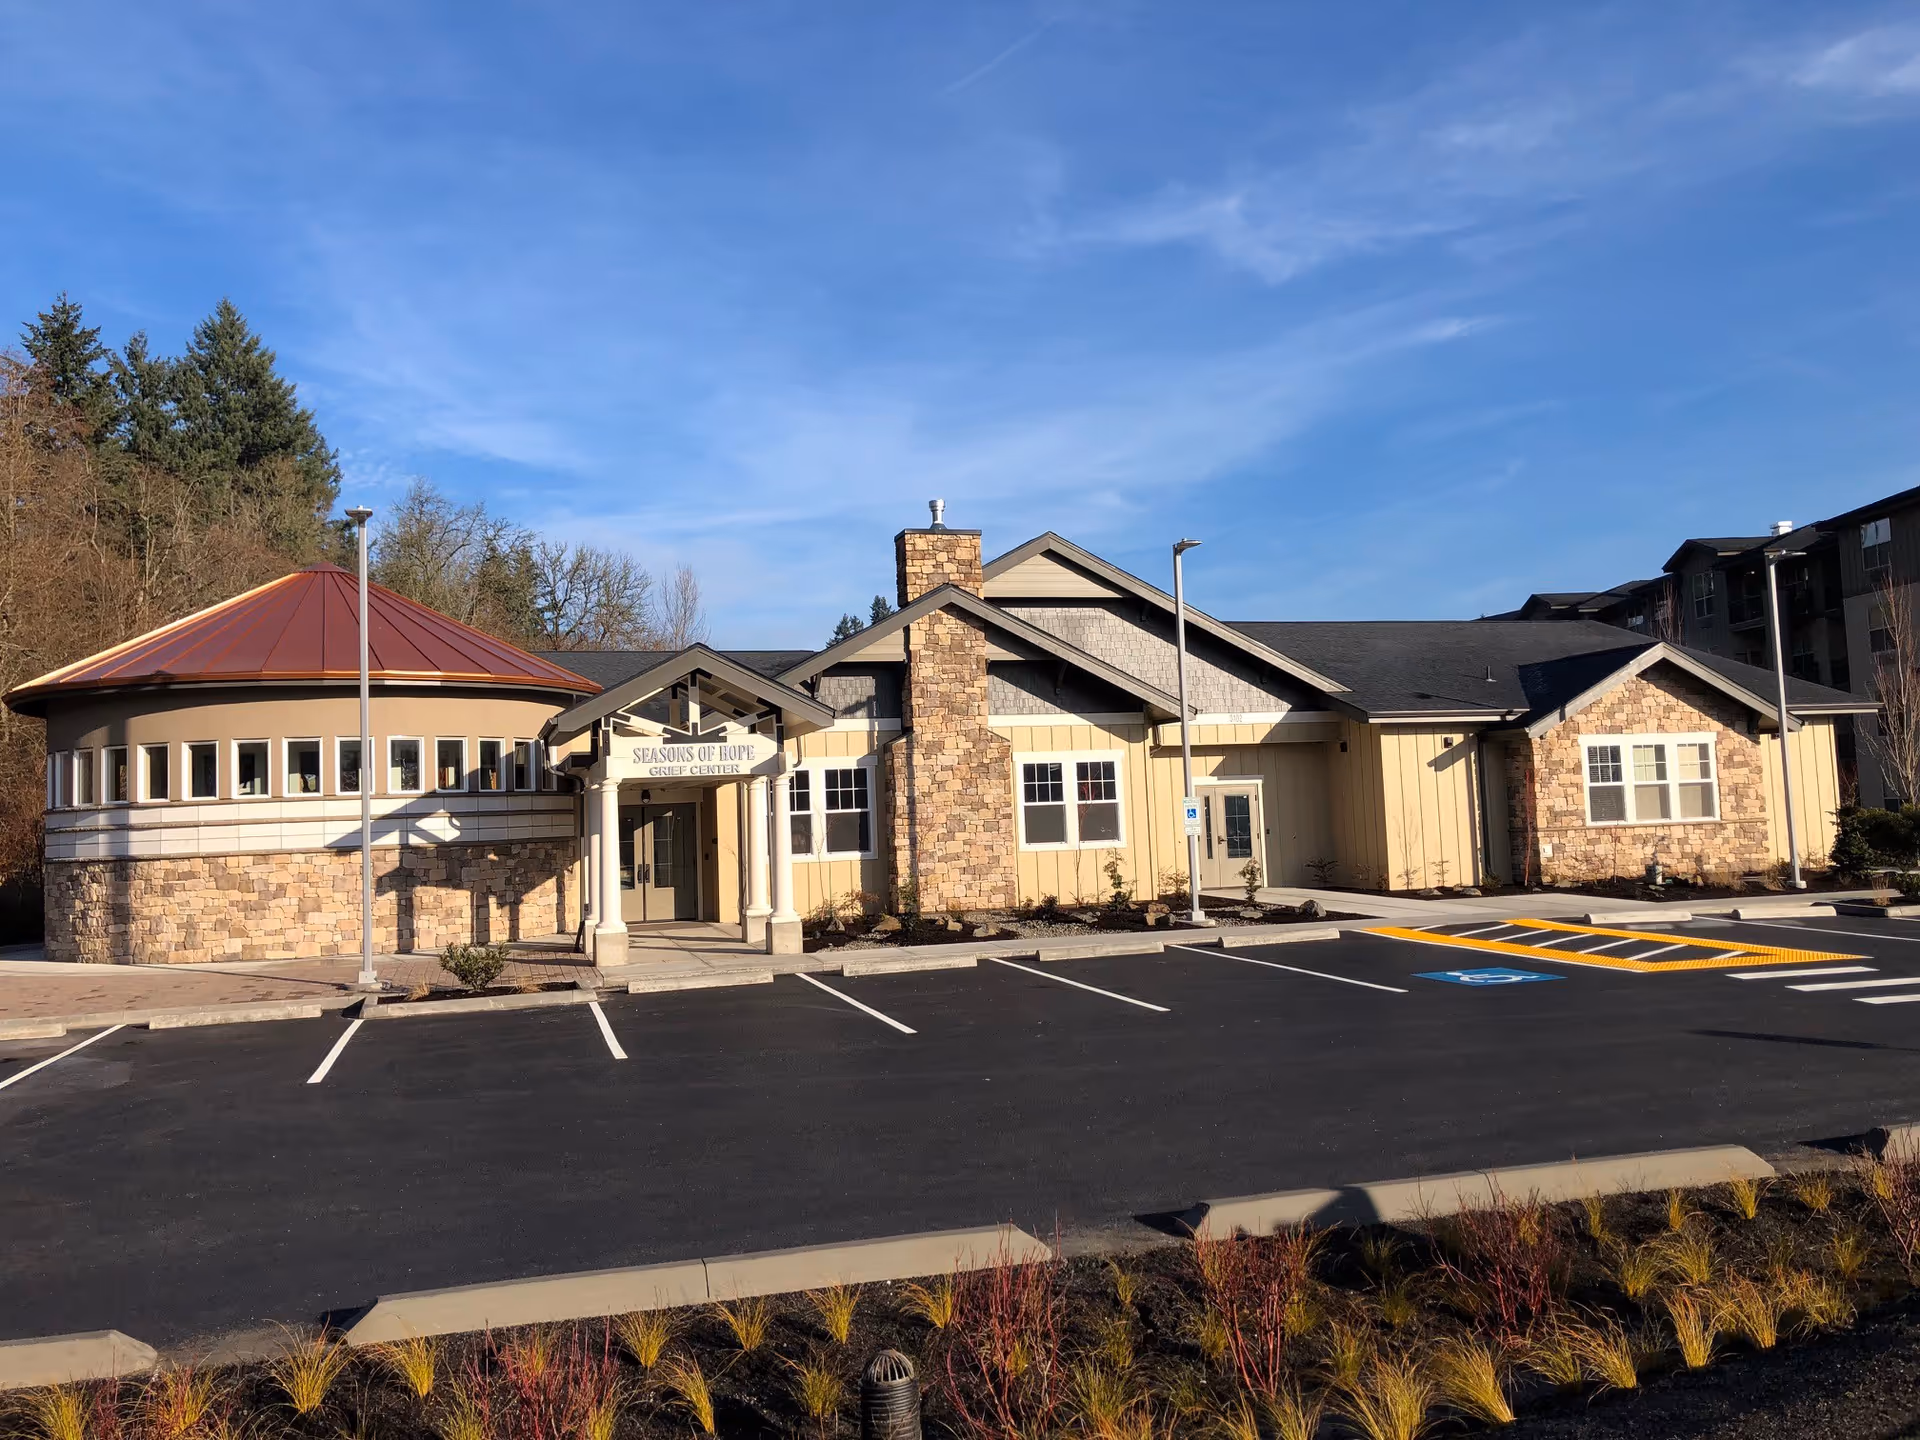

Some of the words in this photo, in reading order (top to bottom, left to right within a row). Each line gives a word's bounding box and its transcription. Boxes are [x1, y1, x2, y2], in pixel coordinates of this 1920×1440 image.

[633, 746, 694, 764] SEASONS
[698, 745, 715, 761] OF
[719, 744, 755, 761] HOPE
[649, 765, 688, 776] GRIEF
[689, 764, 740, 775] CENTER
